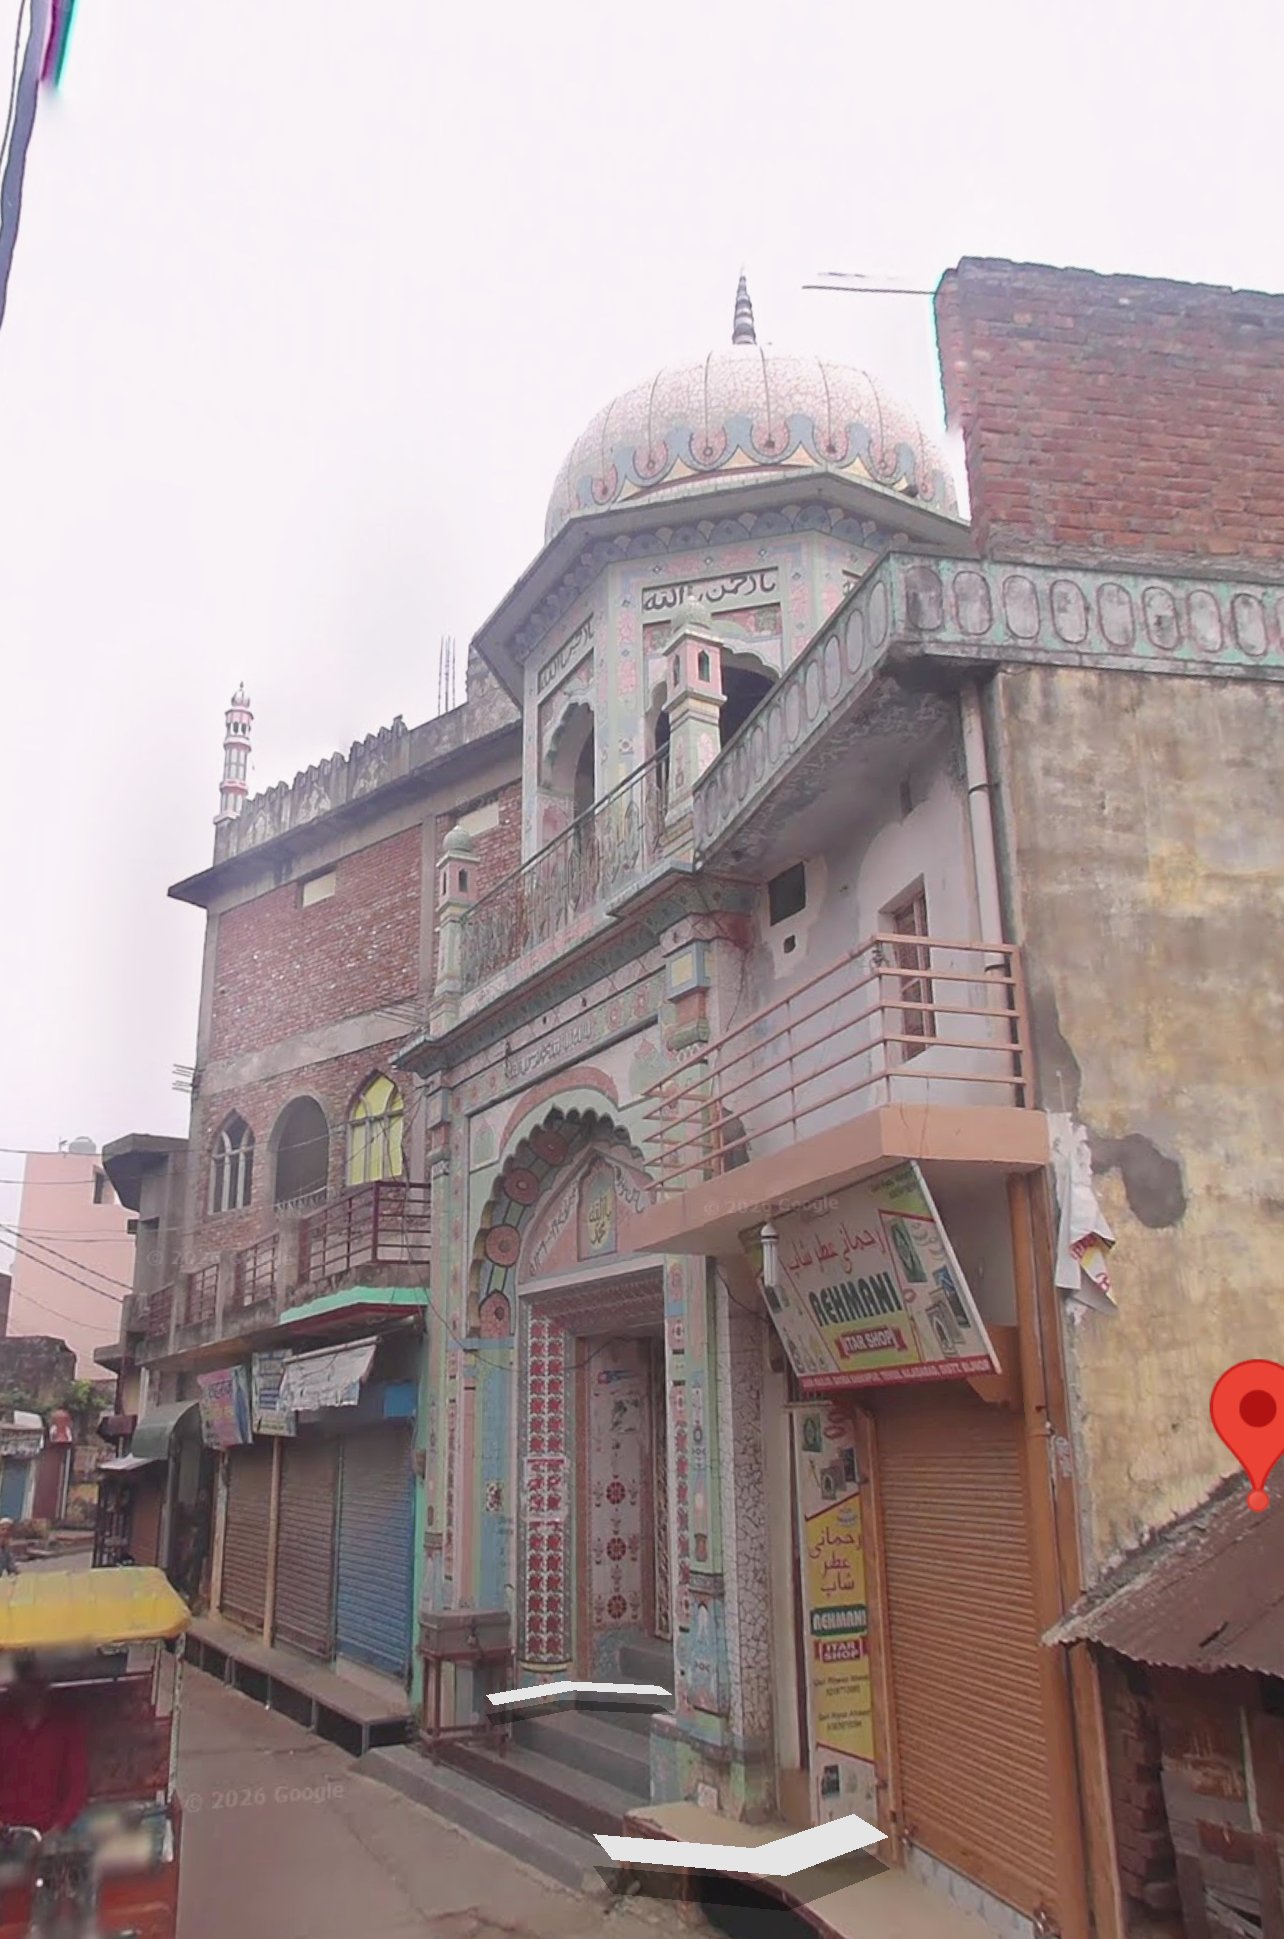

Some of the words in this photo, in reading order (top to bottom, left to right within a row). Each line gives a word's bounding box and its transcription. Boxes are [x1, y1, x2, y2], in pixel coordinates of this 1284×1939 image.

[808, 1270, 902, 1328] REHMANI
[864, 1329, 895, 1350] SHOP
[812, 1609, 867, 1631] REHMANI
[823, 1648, 860, 1661] SHOP
[825, 1641, 856, 1652] ITAR
